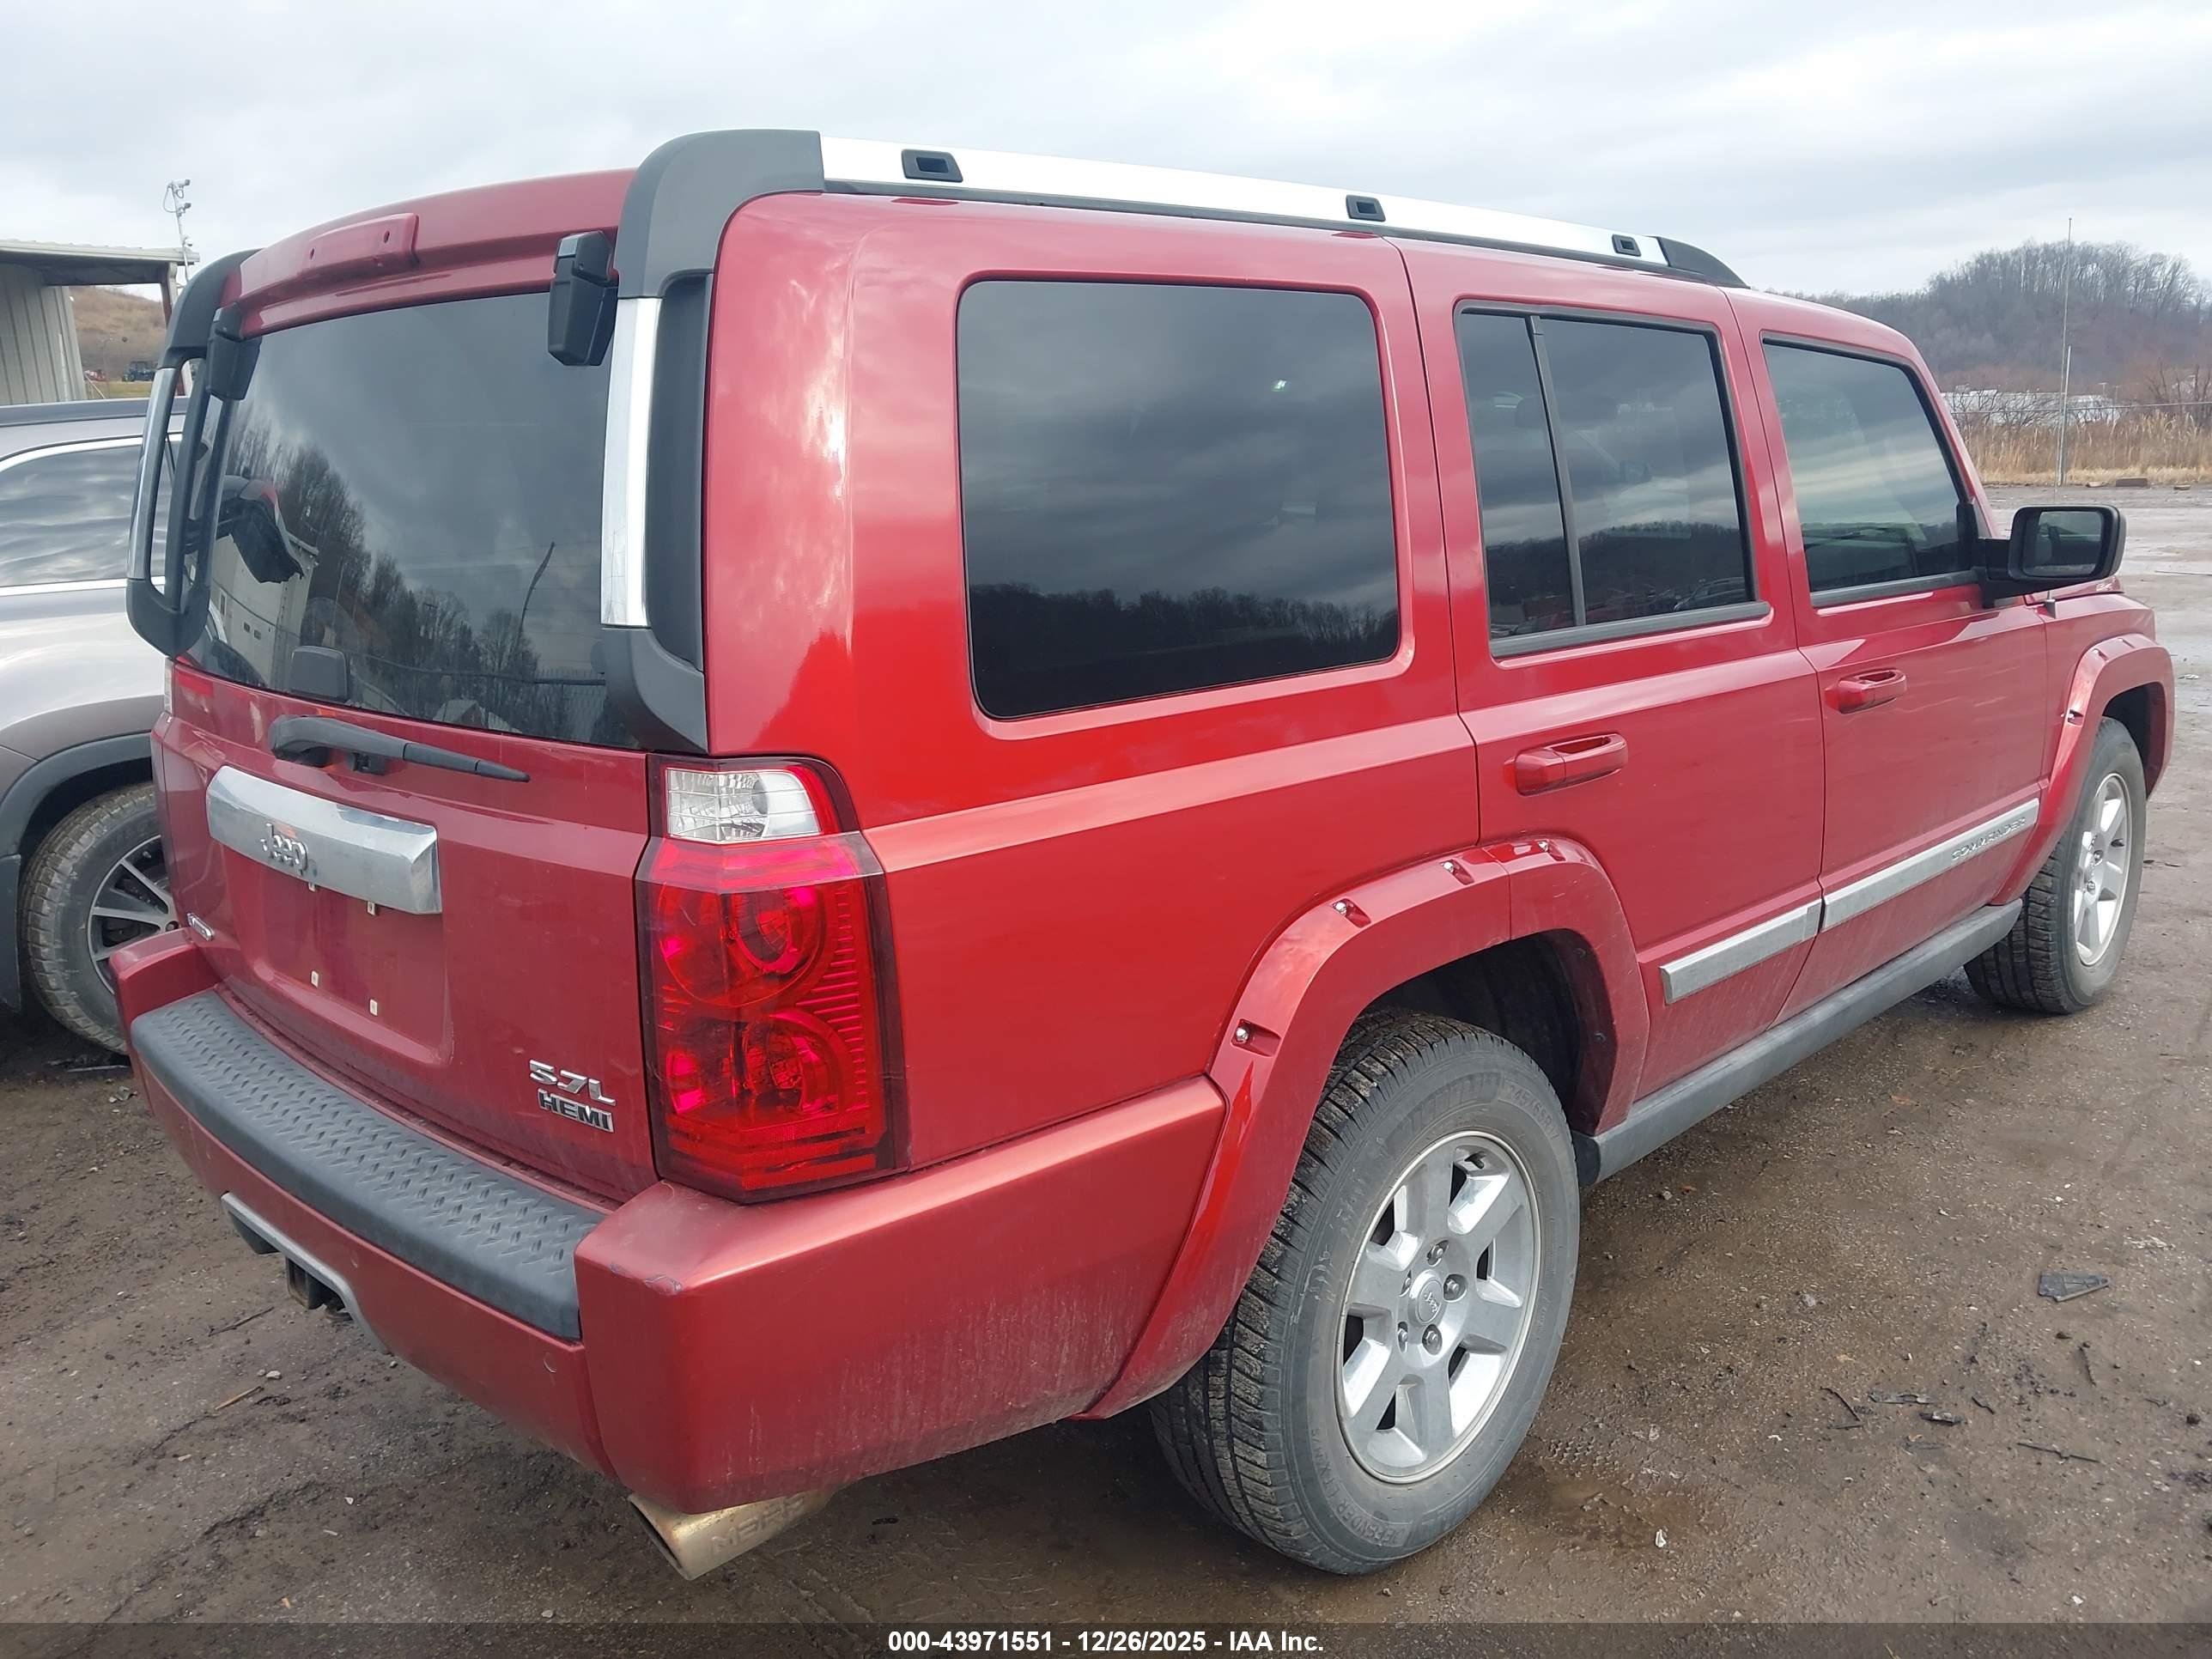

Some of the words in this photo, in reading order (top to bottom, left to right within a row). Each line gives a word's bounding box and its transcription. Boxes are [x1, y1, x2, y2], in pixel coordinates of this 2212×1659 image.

[259, 822, 309, 876] Jeep
[529, 1059, 617, 1107] 5.7L
[538, 1088, 616, 1133] HEMI
